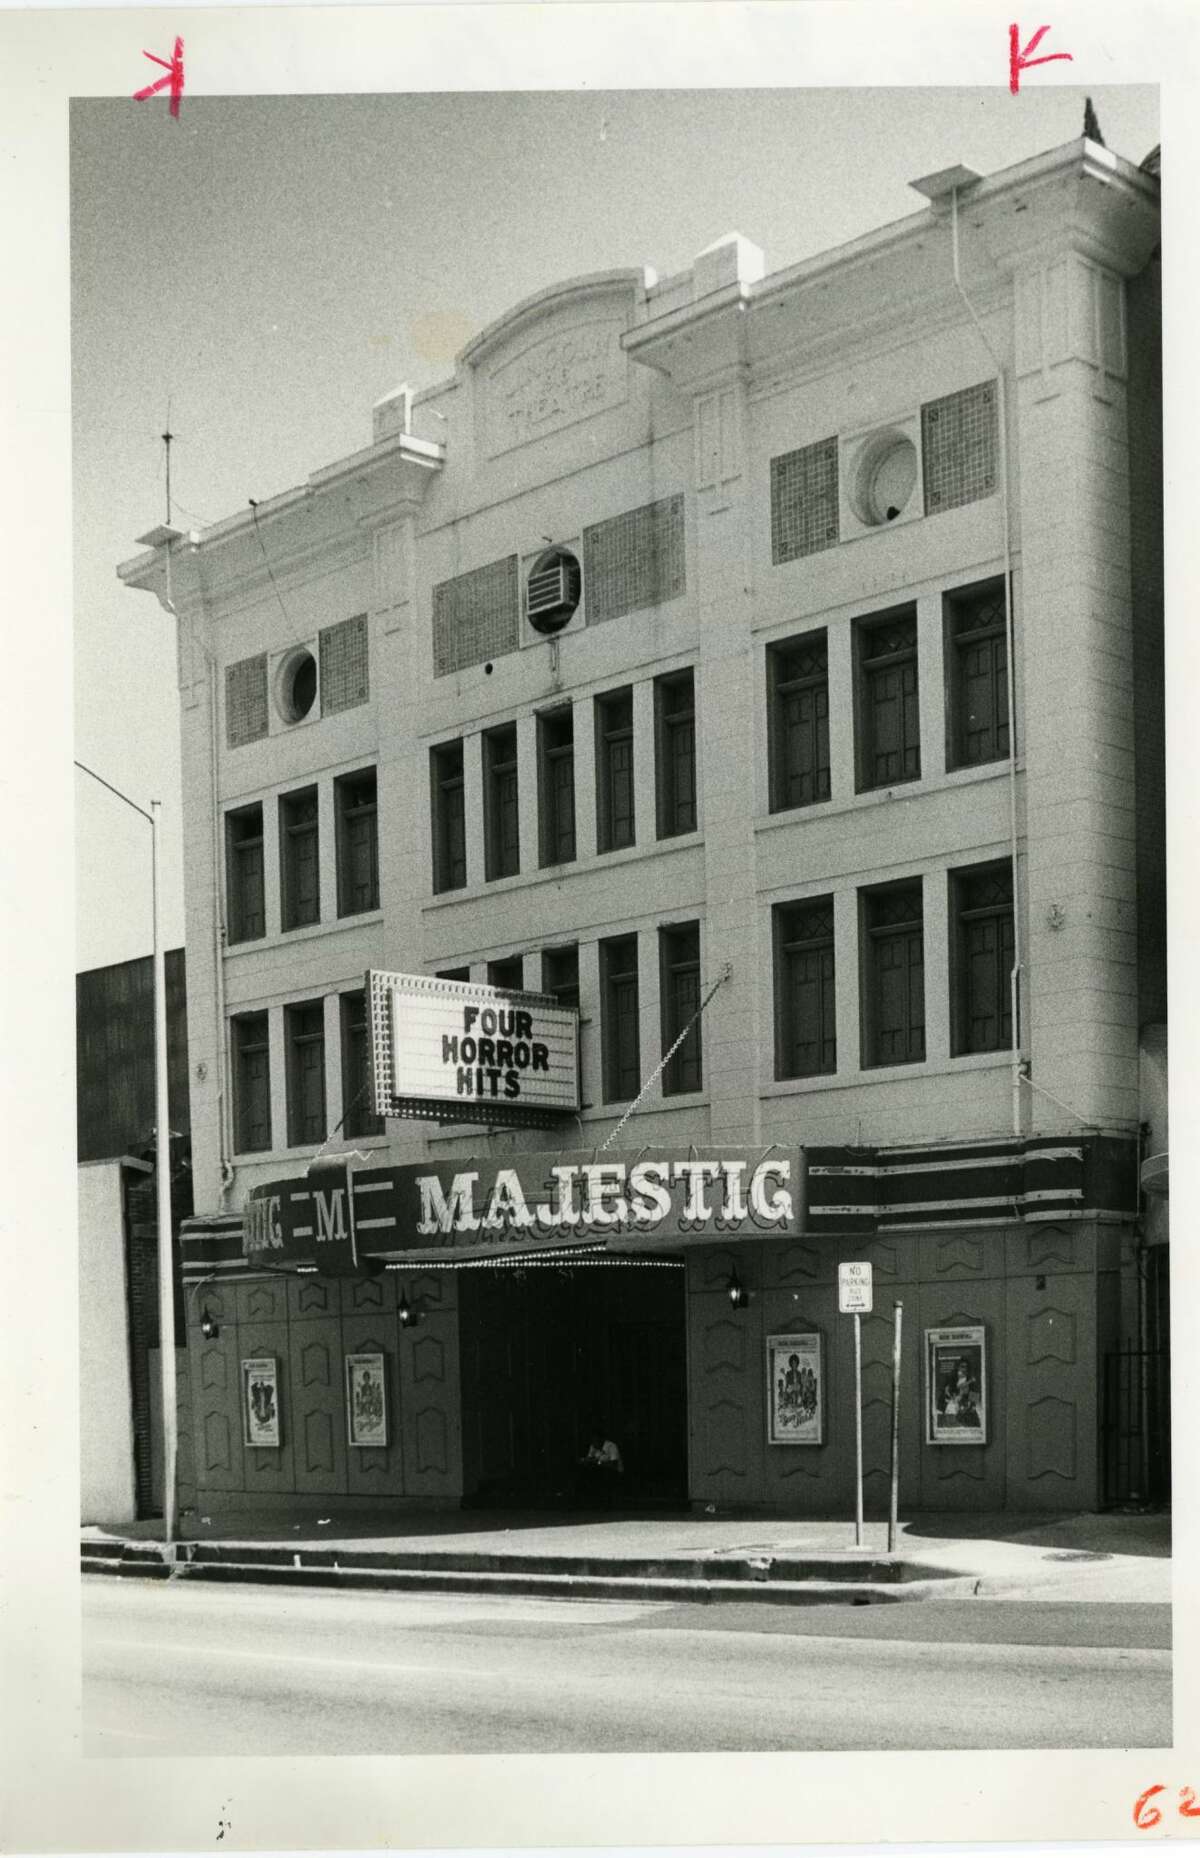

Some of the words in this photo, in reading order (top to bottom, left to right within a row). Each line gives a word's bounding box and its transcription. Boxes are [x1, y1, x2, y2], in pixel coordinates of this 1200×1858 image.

[464, 1006, 533, 1039] FOUR
[442, 1034, 550, 1072] HORROR
[457, 1066, 521, 1099] HITS
[849, 1265, 862, 1276] NO
